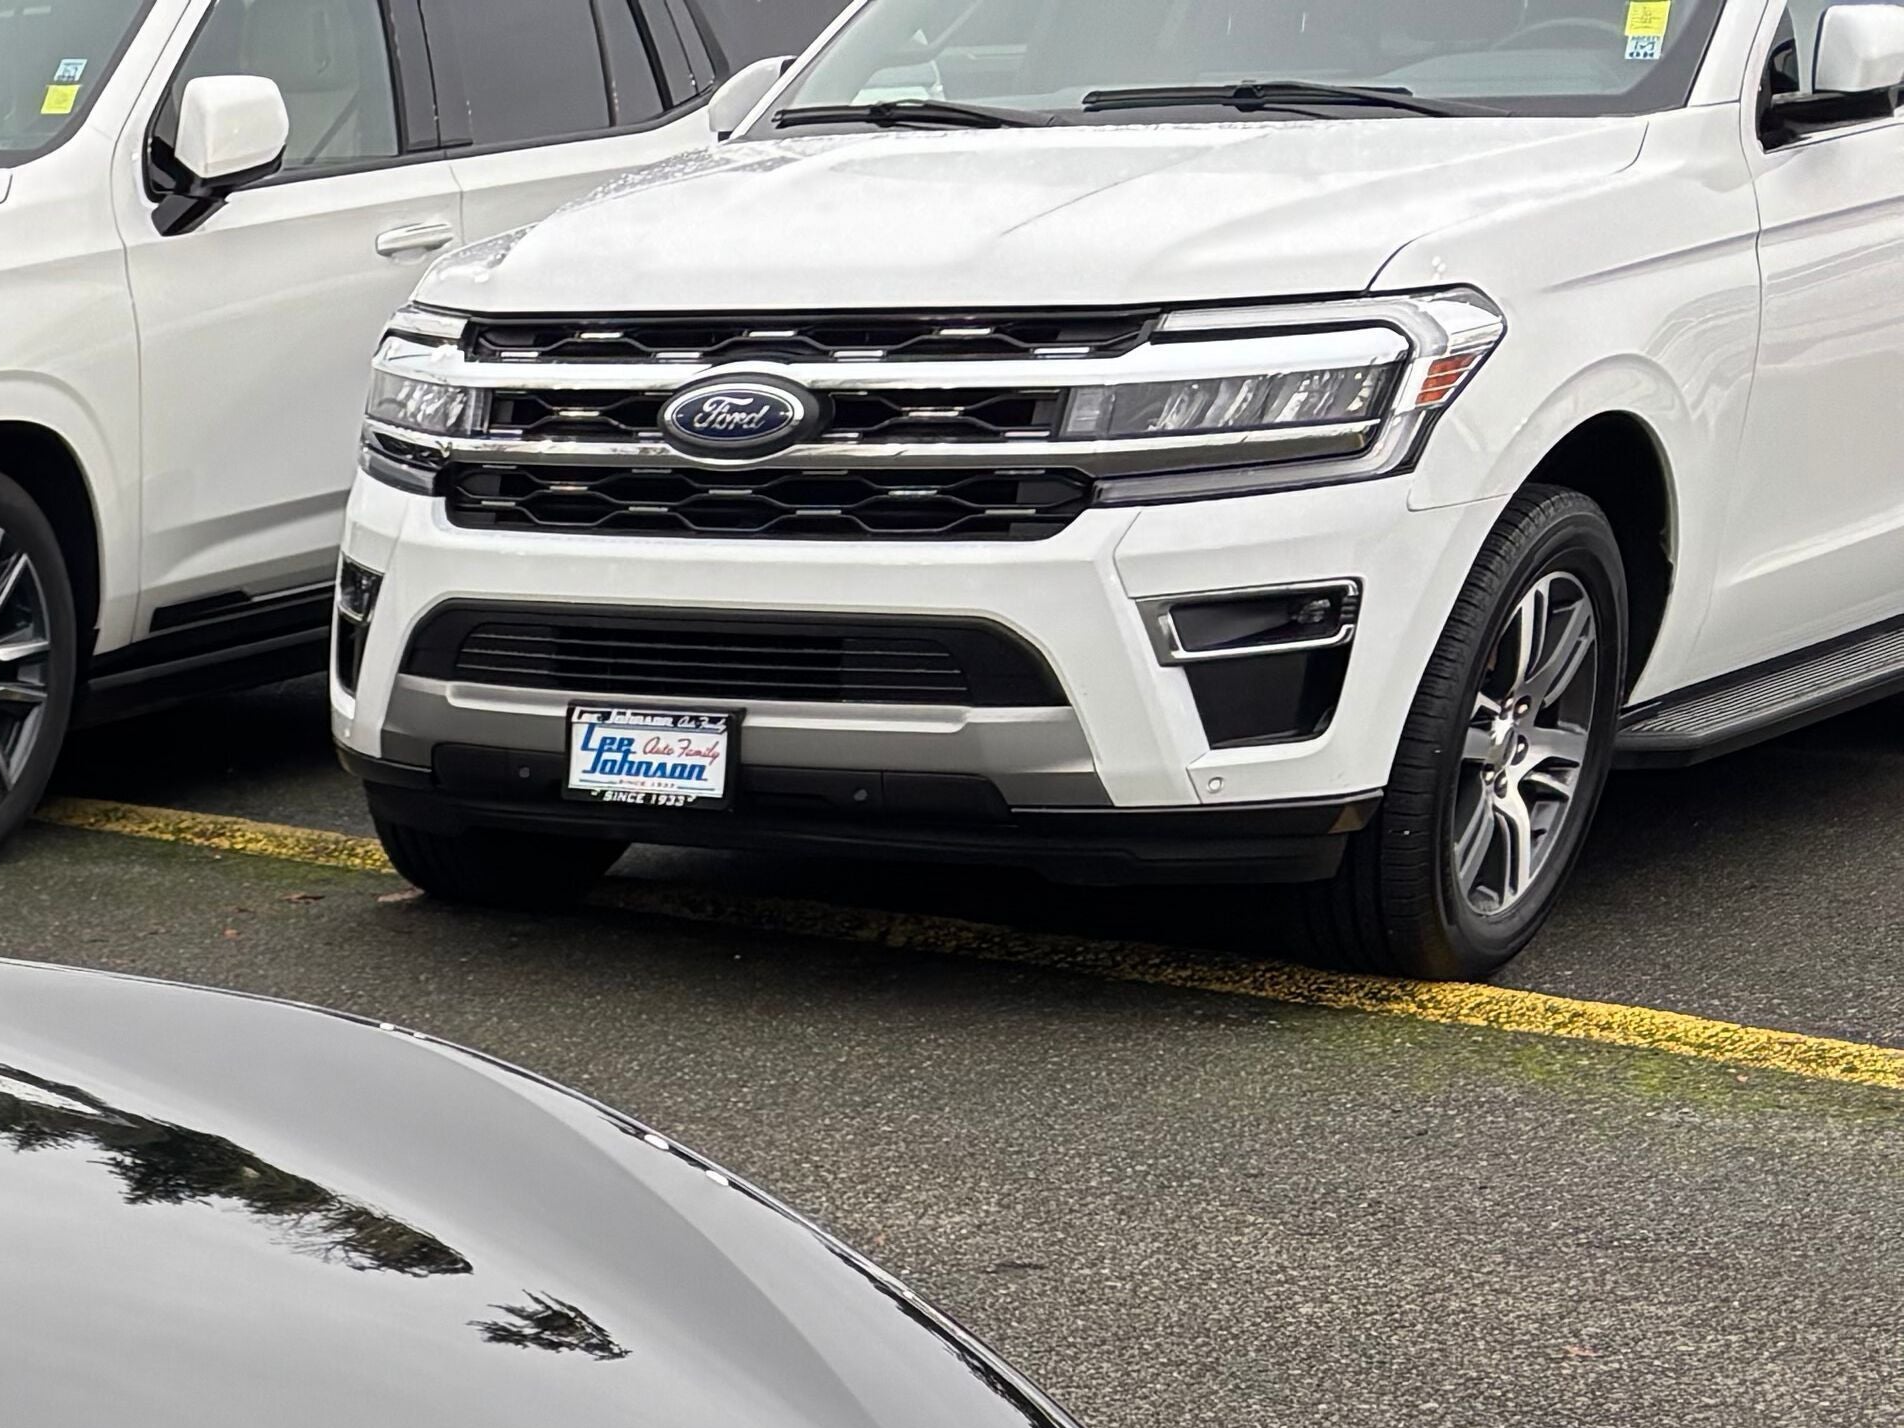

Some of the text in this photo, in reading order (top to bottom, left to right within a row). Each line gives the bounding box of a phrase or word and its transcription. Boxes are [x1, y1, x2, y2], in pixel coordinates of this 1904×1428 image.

[693, 395, 771, 431] Ford
[581, 722, 720, 765] Lee Auto Family
[581, 748, 708, 782] Johnson
[603, 791, 685, 807] SINCE 1933
